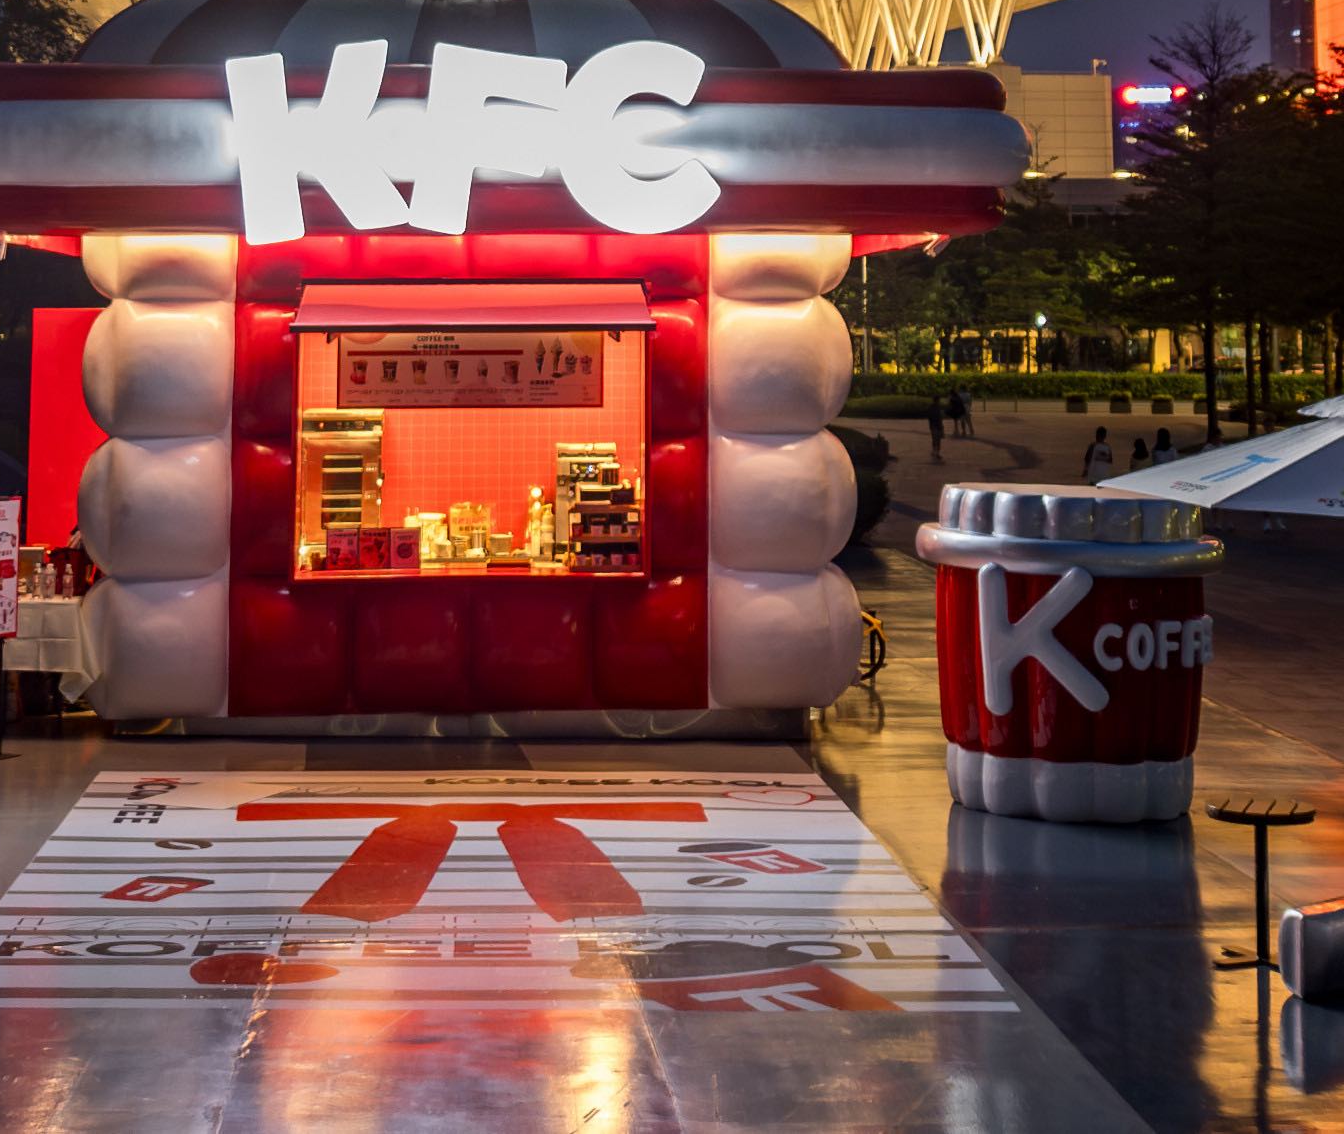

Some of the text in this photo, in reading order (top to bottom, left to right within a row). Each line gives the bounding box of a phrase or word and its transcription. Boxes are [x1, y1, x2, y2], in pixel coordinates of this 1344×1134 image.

[224, 39, 720, 245] KFC
[978, 562, 1110, 716] K
[1094, 615, 1213, 672] COFF
